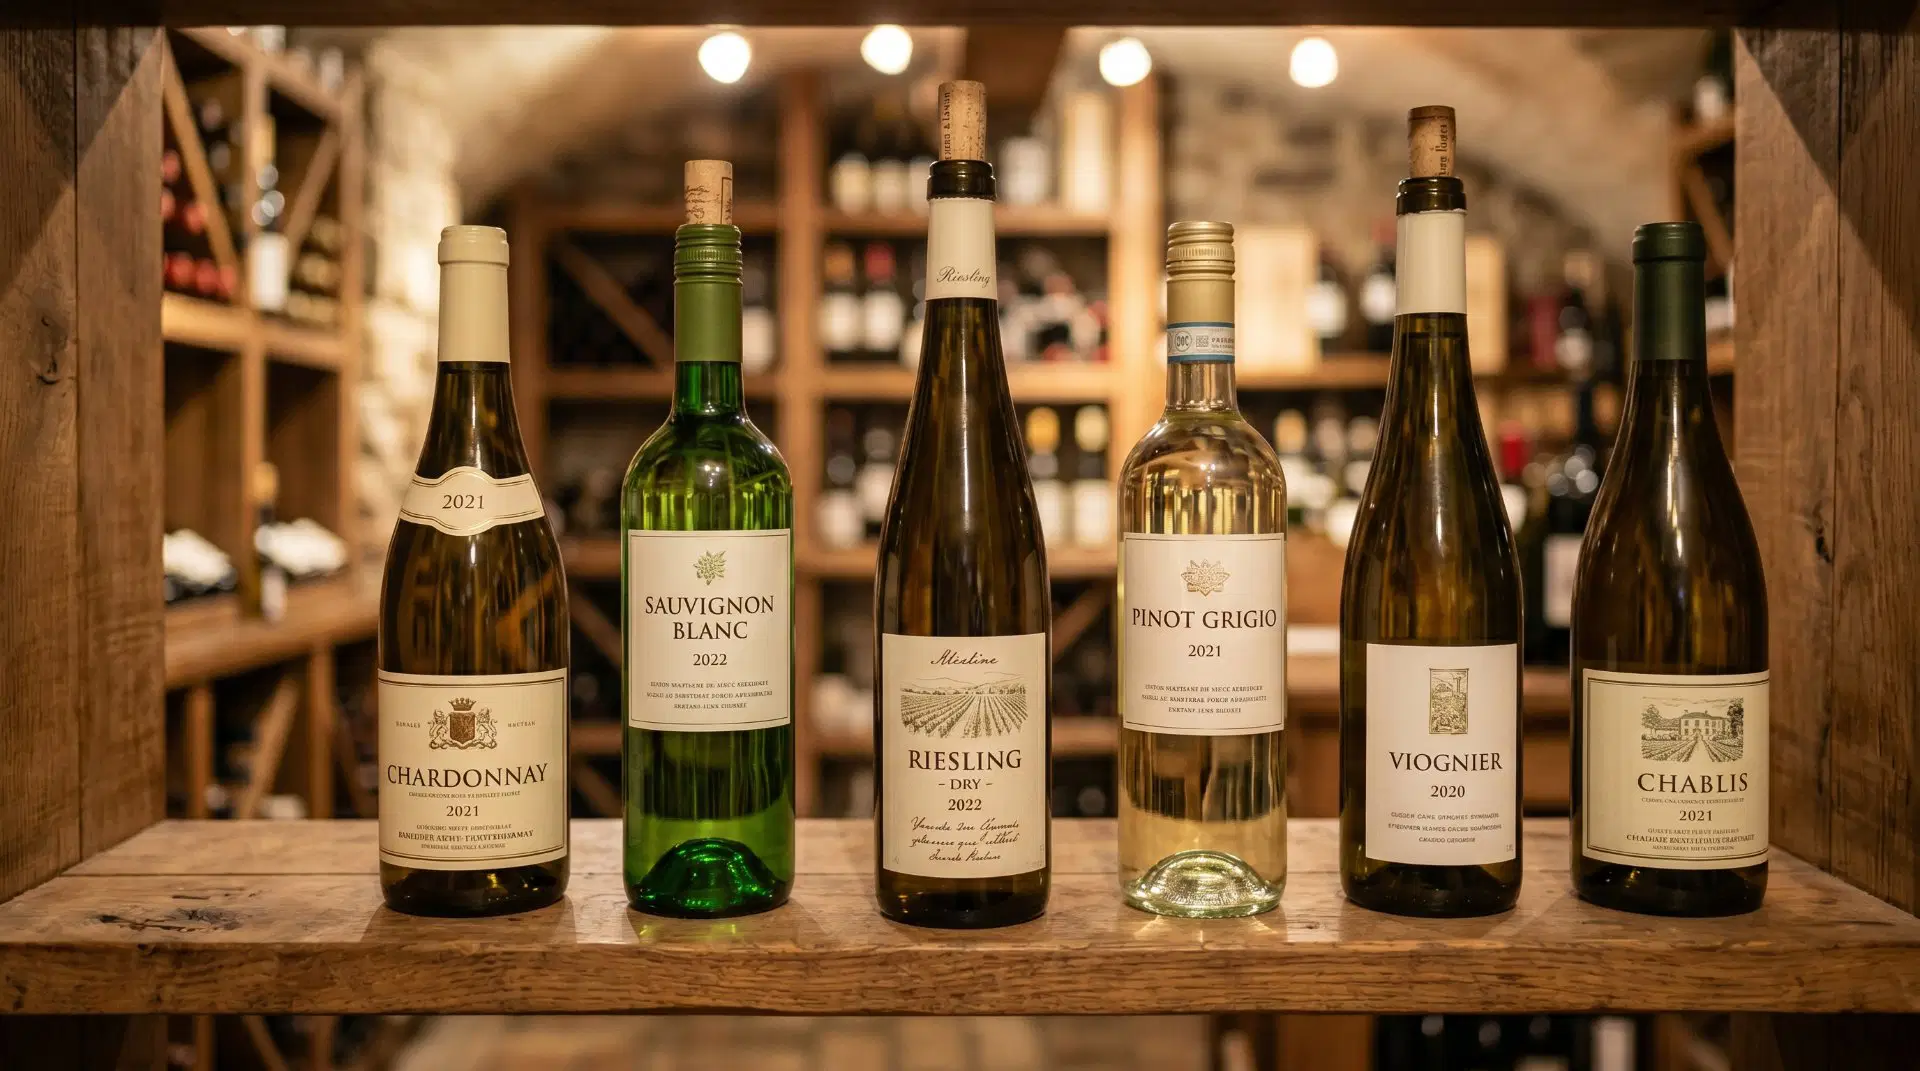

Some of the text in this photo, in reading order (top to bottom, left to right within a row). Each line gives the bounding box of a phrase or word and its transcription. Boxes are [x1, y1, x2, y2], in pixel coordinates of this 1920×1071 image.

[936, 265, 991, 289] Riesling
[442, 494, 485, 509] 2021
[645, 595, 775, 615] SAUVIGNON
[1132, 607, 1277, 629] PINOT GRIGIO
[673, 621, 748, 640] BLANC
[1188, 644, 1221, 657] 2021
[692, 653, 728, 666] 2022
[908, 749, 1022, 771] RIESLING
[1389, 751, 1503, 772] VIOGNIER
[387, 762, 549, 788] CHARDONNAY
[1637, 772, 1748, 794] CHABLIS
[950, 778, 982, 790] DRY
[1430, 785, 1466, 798] 2020
[446, 805, 480, 817] 2021
[947, 799, 982, 812] 2022
[1679, 810, 1713, 821] 2021
